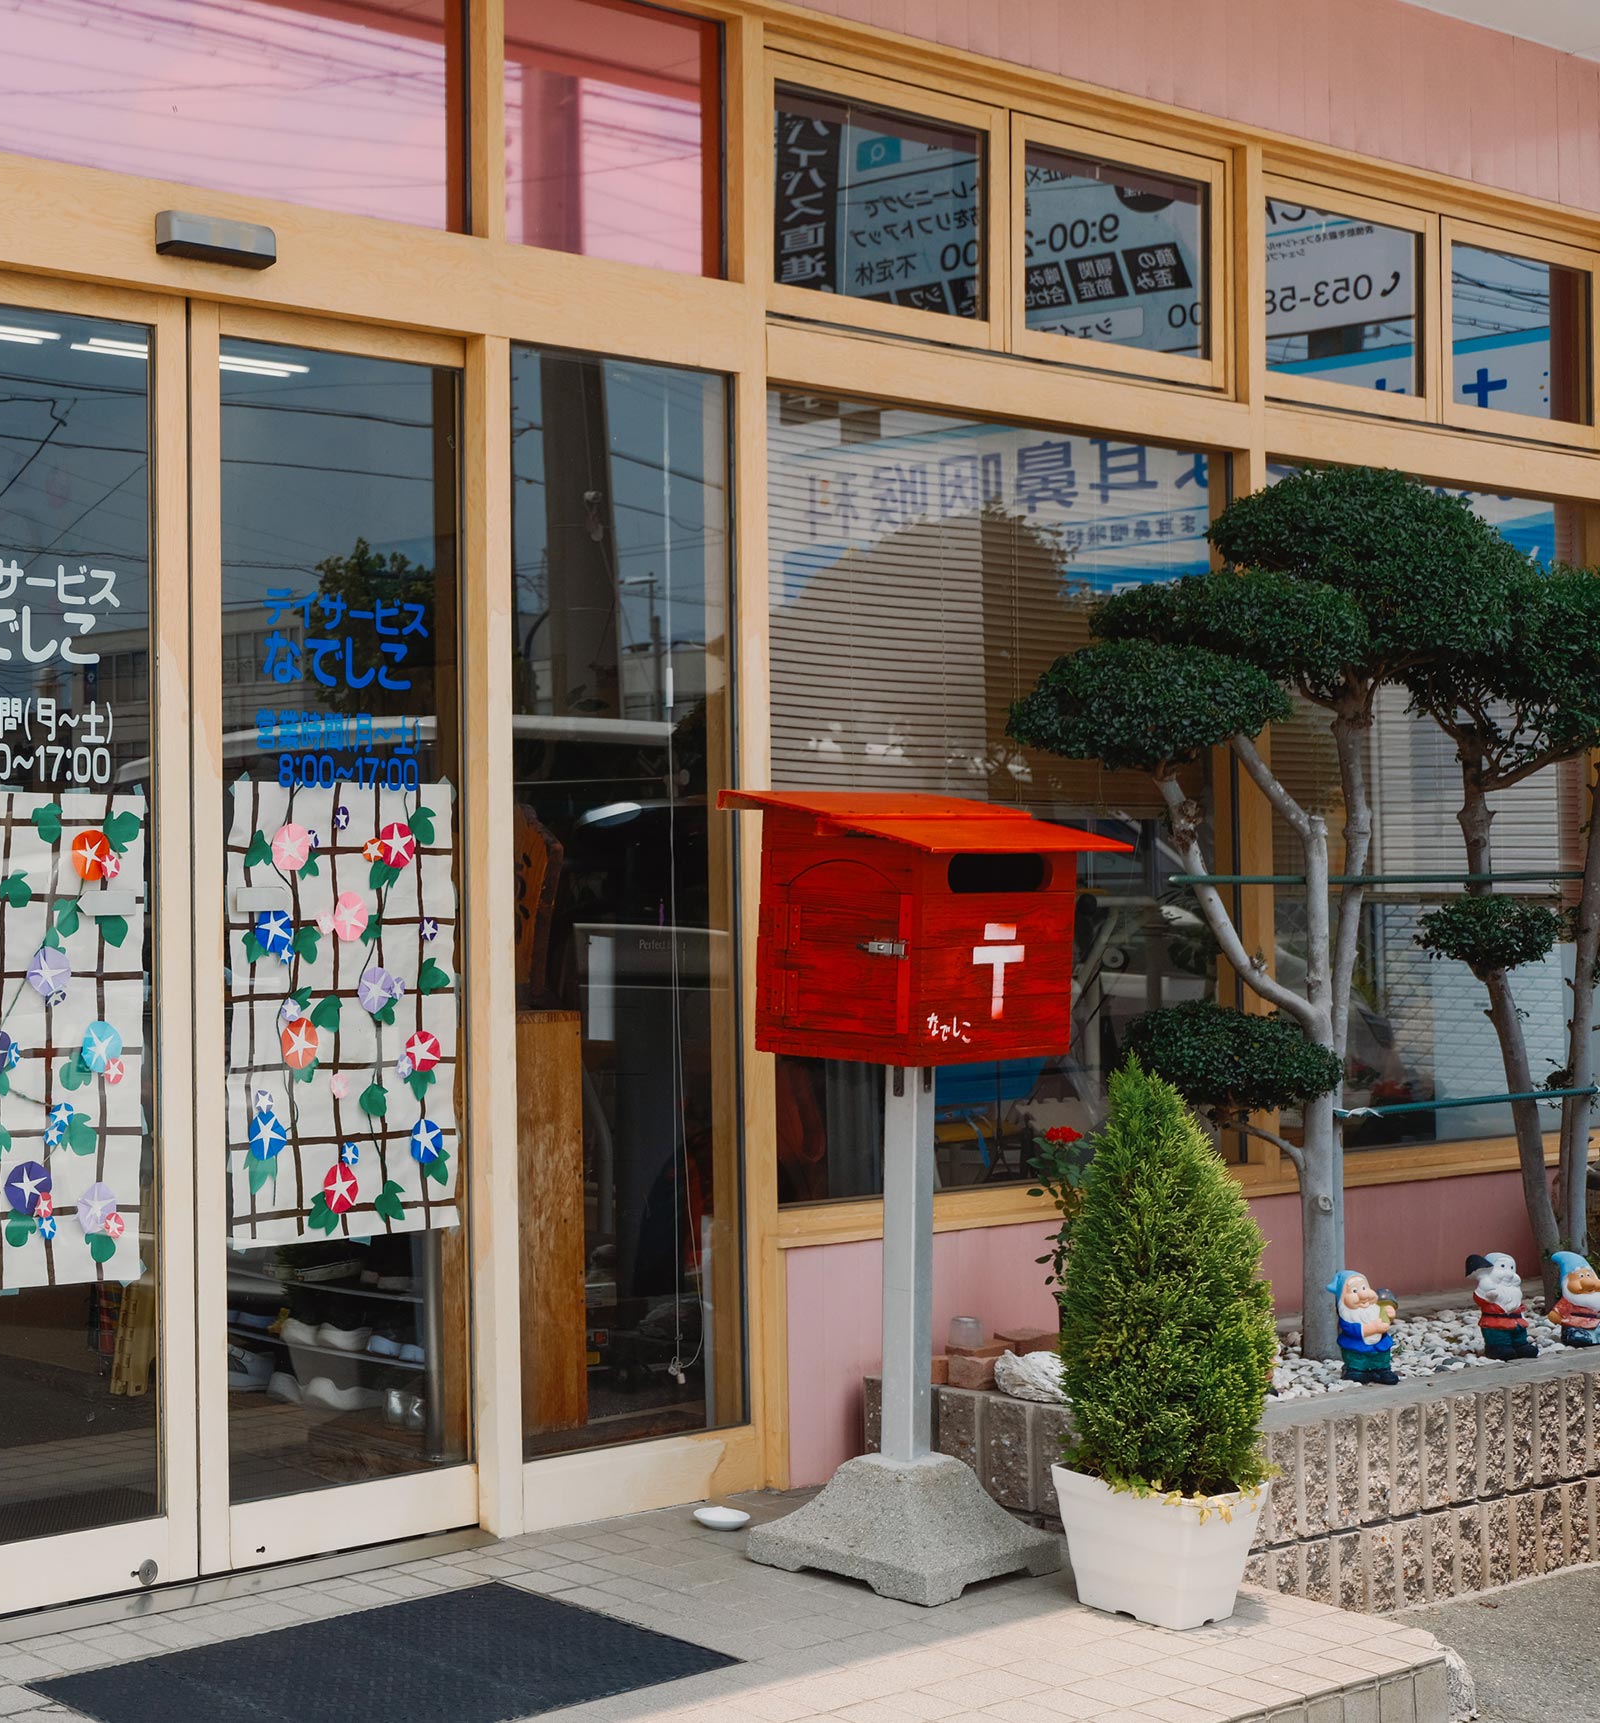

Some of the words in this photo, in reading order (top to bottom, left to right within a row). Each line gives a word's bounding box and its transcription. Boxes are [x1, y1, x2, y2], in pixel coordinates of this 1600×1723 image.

[263, 587, 431, 640] デイサービス
[263, 630, 413, 692] なでしこ
[926, 1012, 973, 1045] なでしこ
